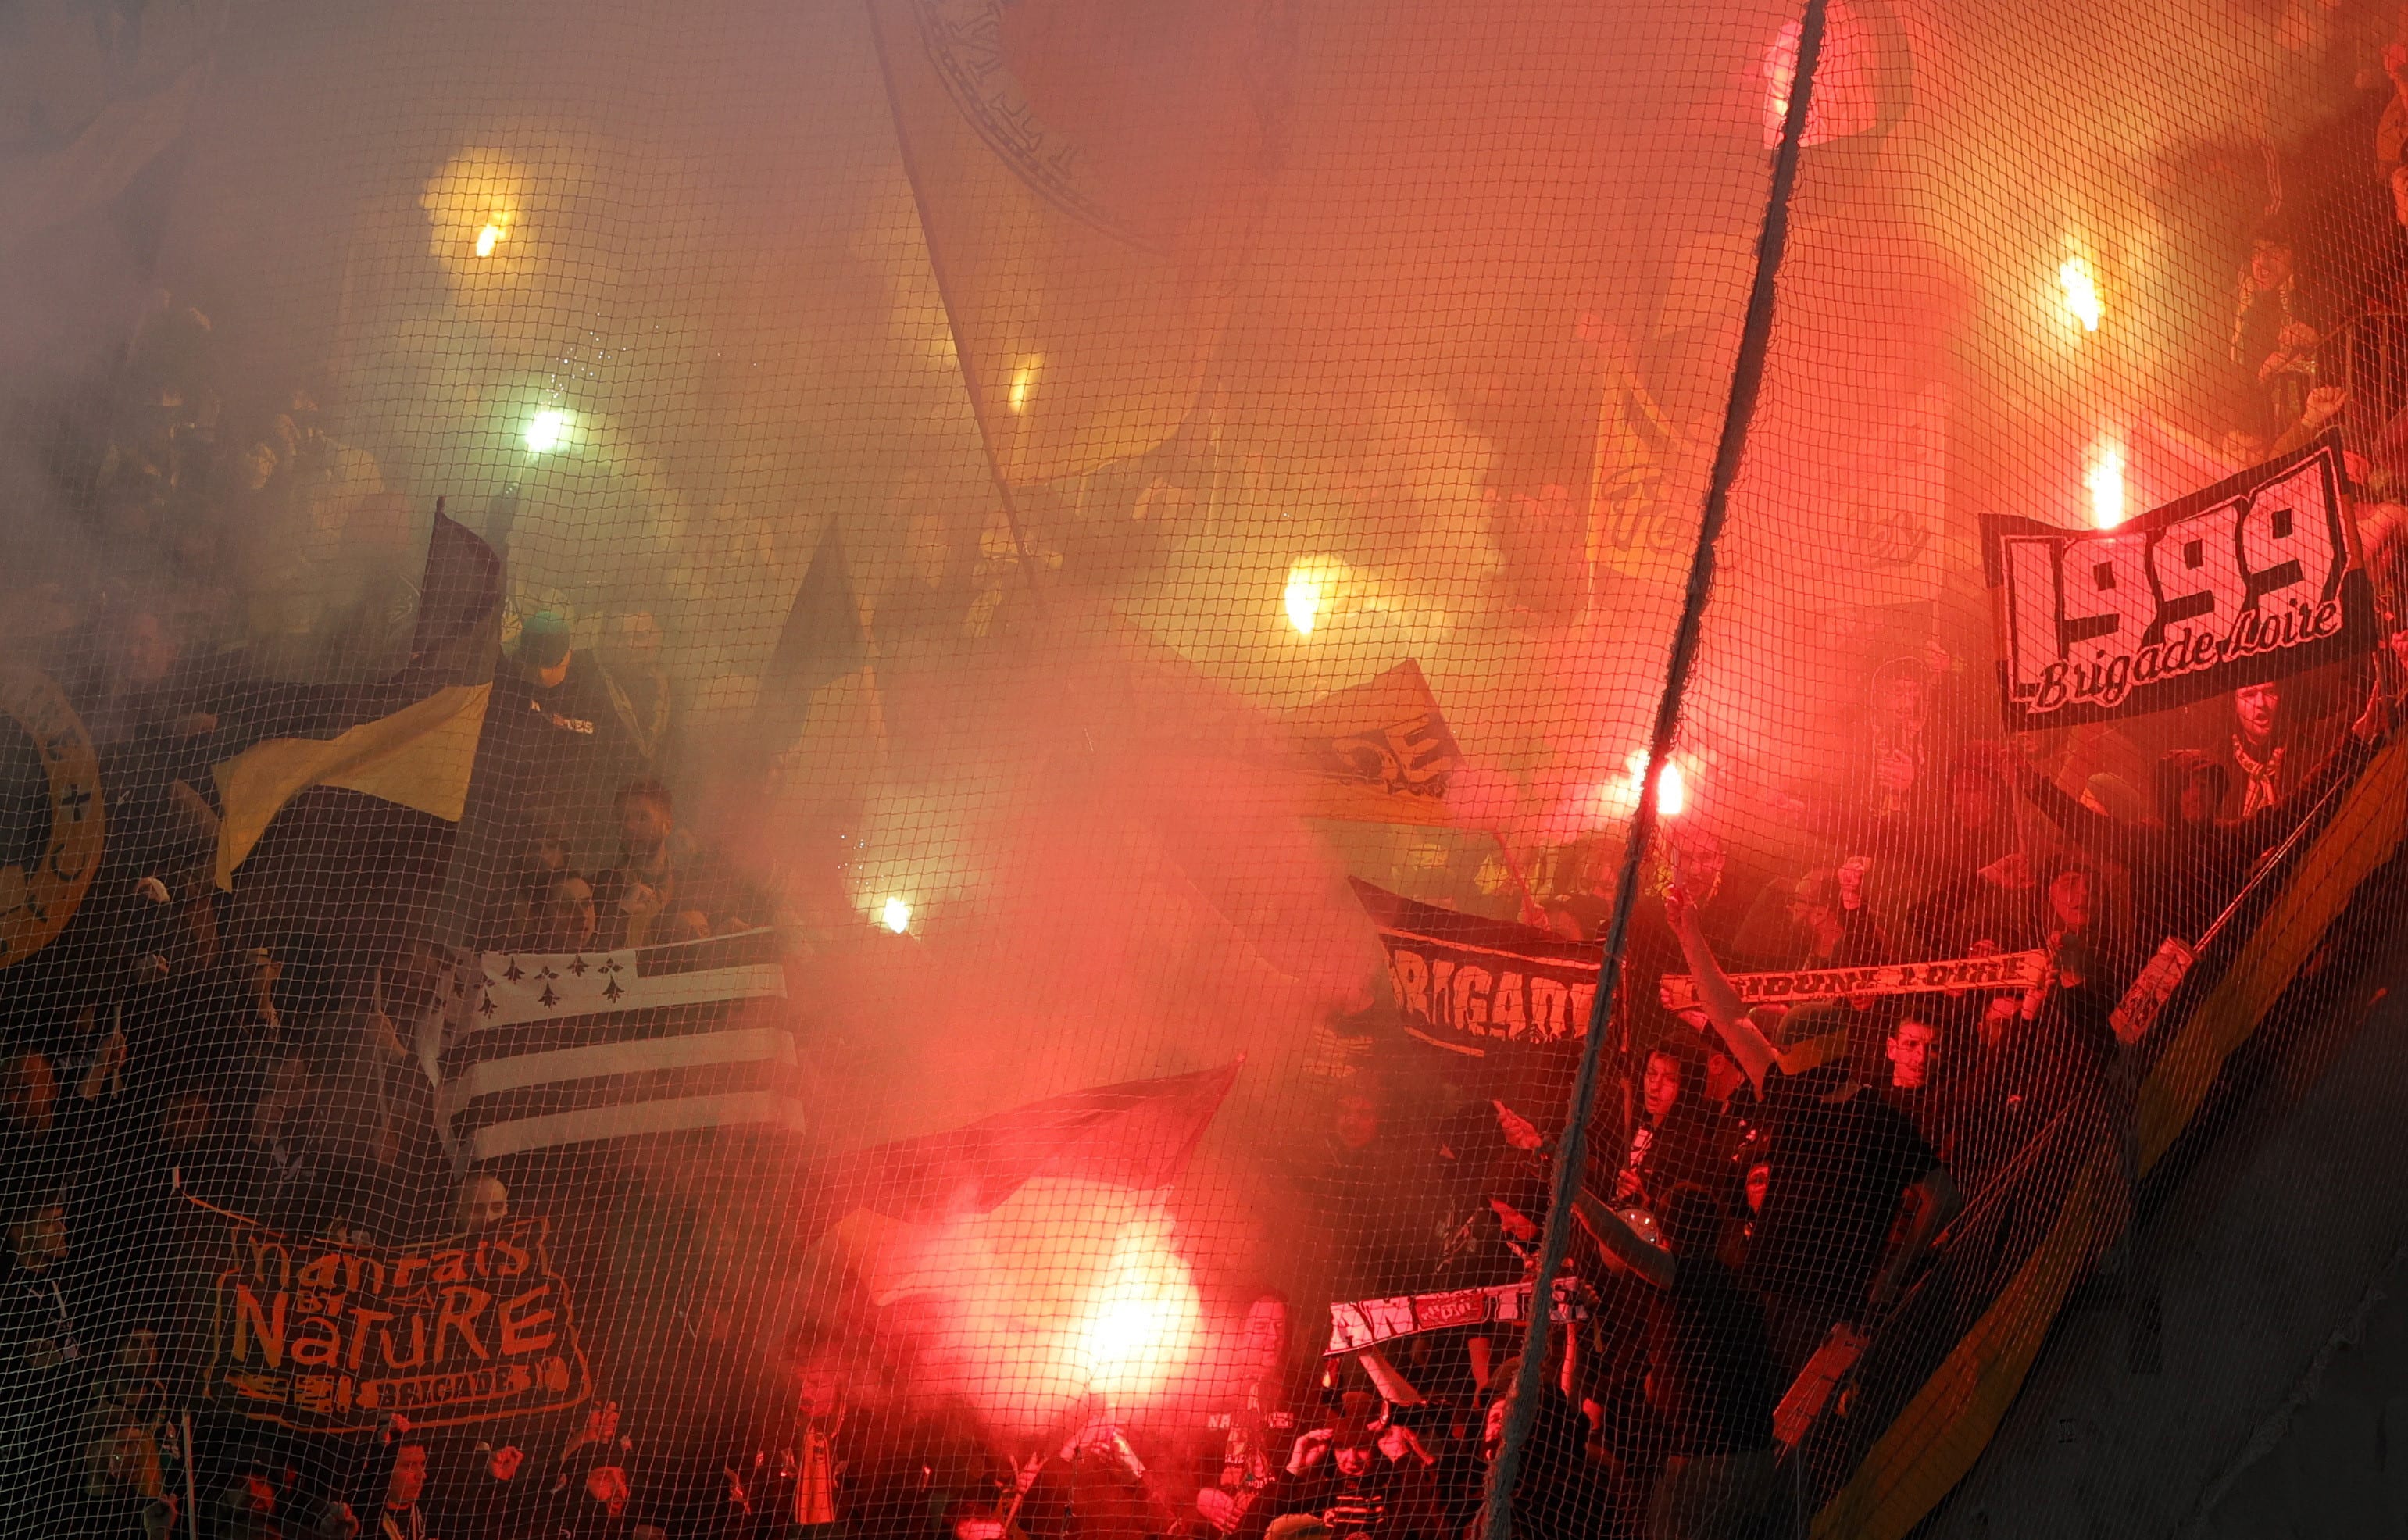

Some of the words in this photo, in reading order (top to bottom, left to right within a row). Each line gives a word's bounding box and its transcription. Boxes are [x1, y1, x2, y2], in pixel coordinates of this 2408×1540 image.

[2009, 461, 2336, 686] 1999
[2036, 627, 2217, 709] Brigade
[2227, 598, 2339, 655] Loire
[377, 1366, 513, 1407] BRIGADE
